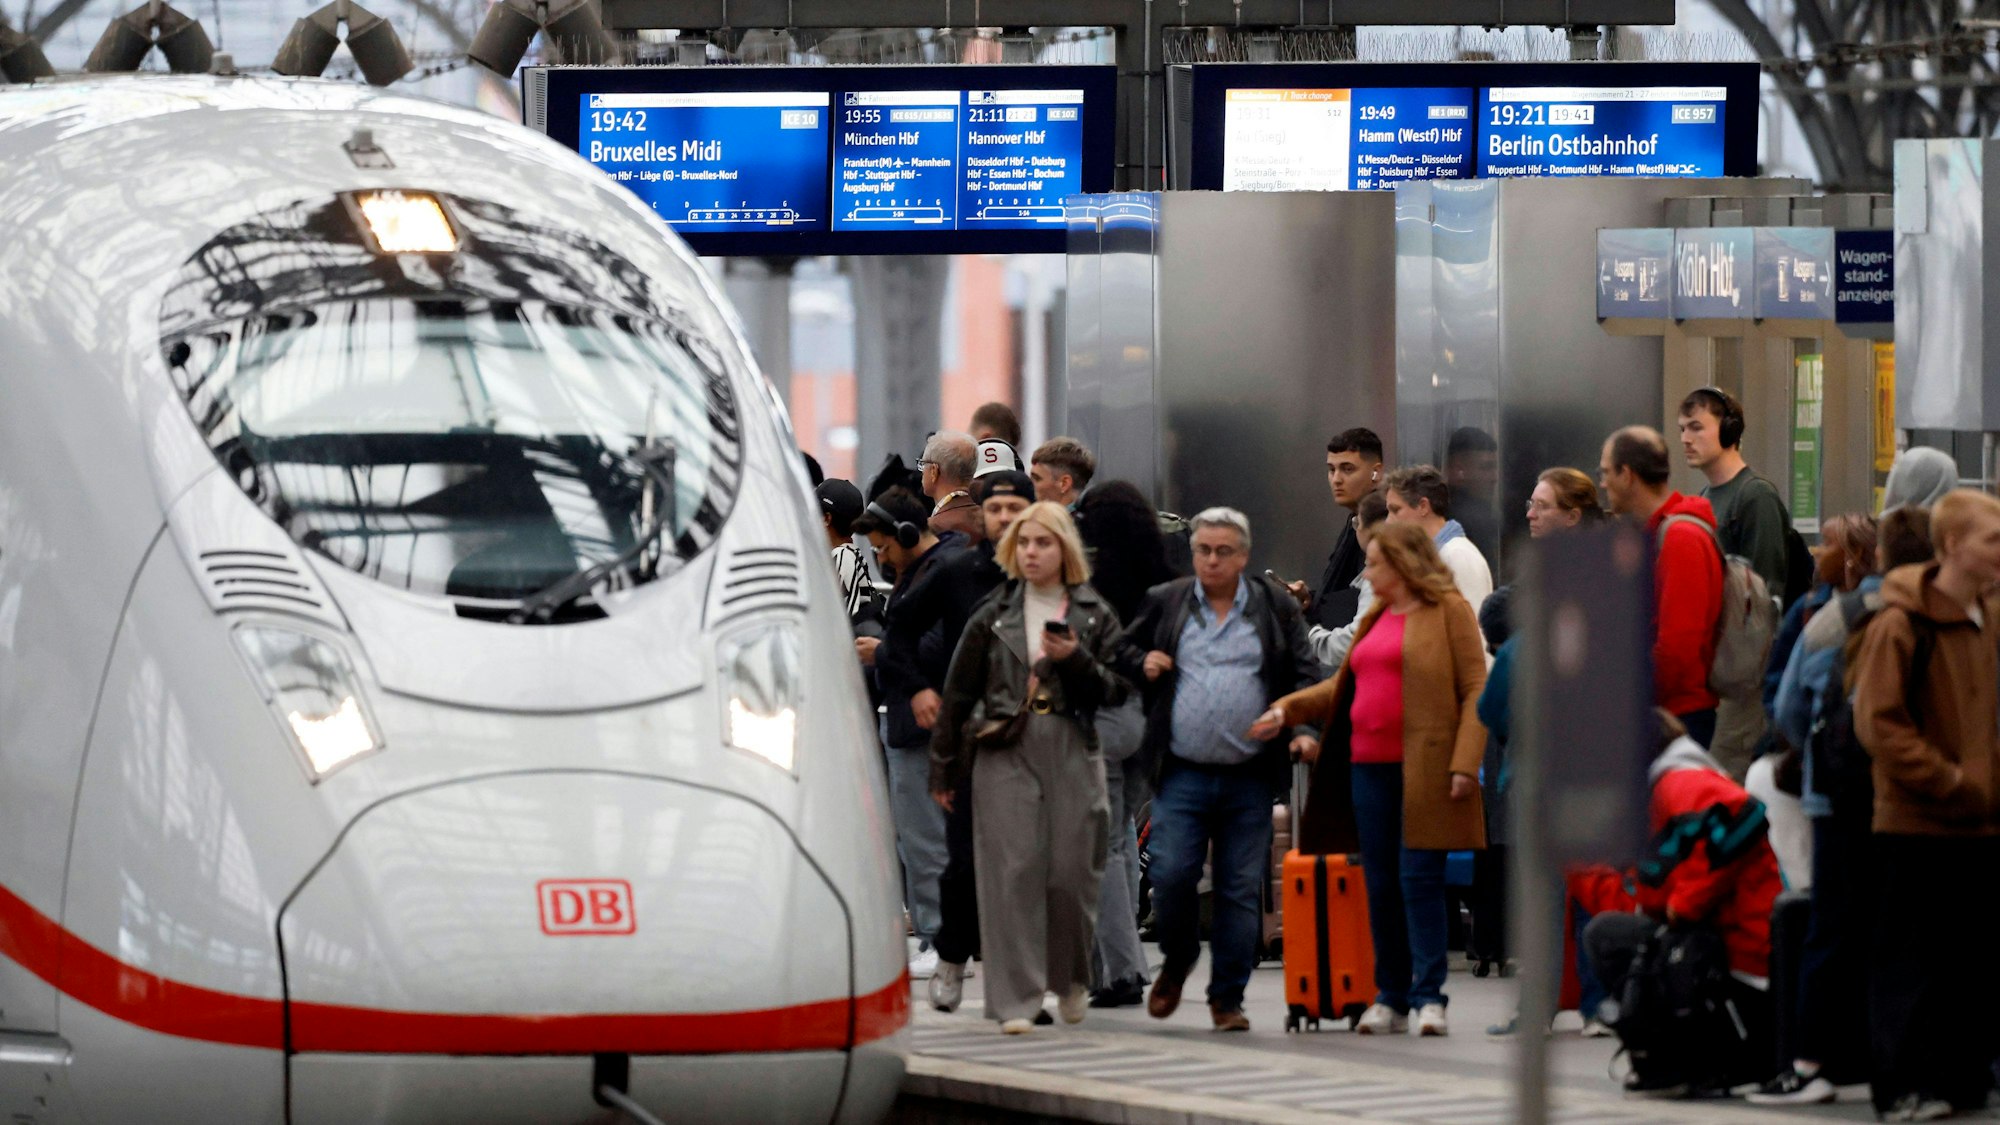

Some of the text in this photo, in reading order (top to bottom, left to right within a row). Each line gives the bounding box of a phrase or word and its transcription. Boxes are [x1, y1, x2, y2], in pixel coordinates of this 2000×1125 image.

[845, 109, 881, 123] 19:55
[968, 109, 1004, 122] 21:11
[1062, 110, 1075, 118] 102
[1360, 106, 1395, 120] 19:49
[1441, 108, 1445, 116] 1
[1490, 105, 1590, 125] 19:21 19:41
[1674, 109, 1713, 120] ICE 957
[590, 111, 647, 132] 19:42
[784, 114, 816, 125] ICE 10
[844, 132, 919, 146] München Hbf
[968, 131, 1046, 145] Hannover Hbf
[1359, 128, 1462, 144] Hamm (Westf) Hbf
[590, 140, 722, 162] Bruxelles Midi
[1490, 134, 1658, 156] Berlin Ostbahnhof
[911, 158, 951, 167] Mannheim
[968, 157, 1008, 167] Düsseldorf
[1010, 157, 1024, 166] Hbf
[1031, 157, 1065, 168] Duisburg
[1358, 155, 1364, 164] K
[1365, 154, 1414, 164] Messe/Deutz
[1422, 154, 1462, 164] Düsseldorf
[844, 170, 858, 179] Hbf
[865, 170, 900, 181] Stuttgart
[901, 170, 915, 179] Hbf
[967, 169, 982, 178] Hbf
[989, 169, 1010, 178] Essen
[1012, 169, 1026, 178] Hbf
[1034, 169, 1064, 178] Bochum
[1234, 168, 1276, 177] Steinstraße
[1358, 167, 1372, 176] Hbf
[1379, 167, 1412, 178] Duisburg
[1415, 167, 1428, 176] Hbf
[1436, 167, 1458, 176] Essen
[1488, 164, 1526, 175] Wuppertal
[1527, 164, 1542, 174] Hbf
[1550, 164, 1587, 174] Dortmund
[1588, 164, 1602, 174] Hbf
[1610, 164, 1634, 174] Hamm
[1636, 164, 1664, 175] (Westf)
[1665, 164, 1679, 174] Hbf
[618, 170, 632, 180] Hbf
[640, 170, 660, 182] Liège
[663, 170, 674, 181] (G)
[682, 170, 738, 180] Bruxelles-Nord
[843, 182, 895, 193] Augsburg Hbf
[967, 182, 981, 191] Hbf
[989, 181, 1026, 191] Dortmund
[1028, 181, 1043, 190] Hbf
[1357, 180, 1372, 189] Hbf
[1840, 250, 1893, 266] Wagen-
[1678, 241, 1734, 297] Köln Hbf
[1844, 269, 1889, 282] stand-
[985, 448, 998, 463] S
[551, 889, 622, 925] DB
